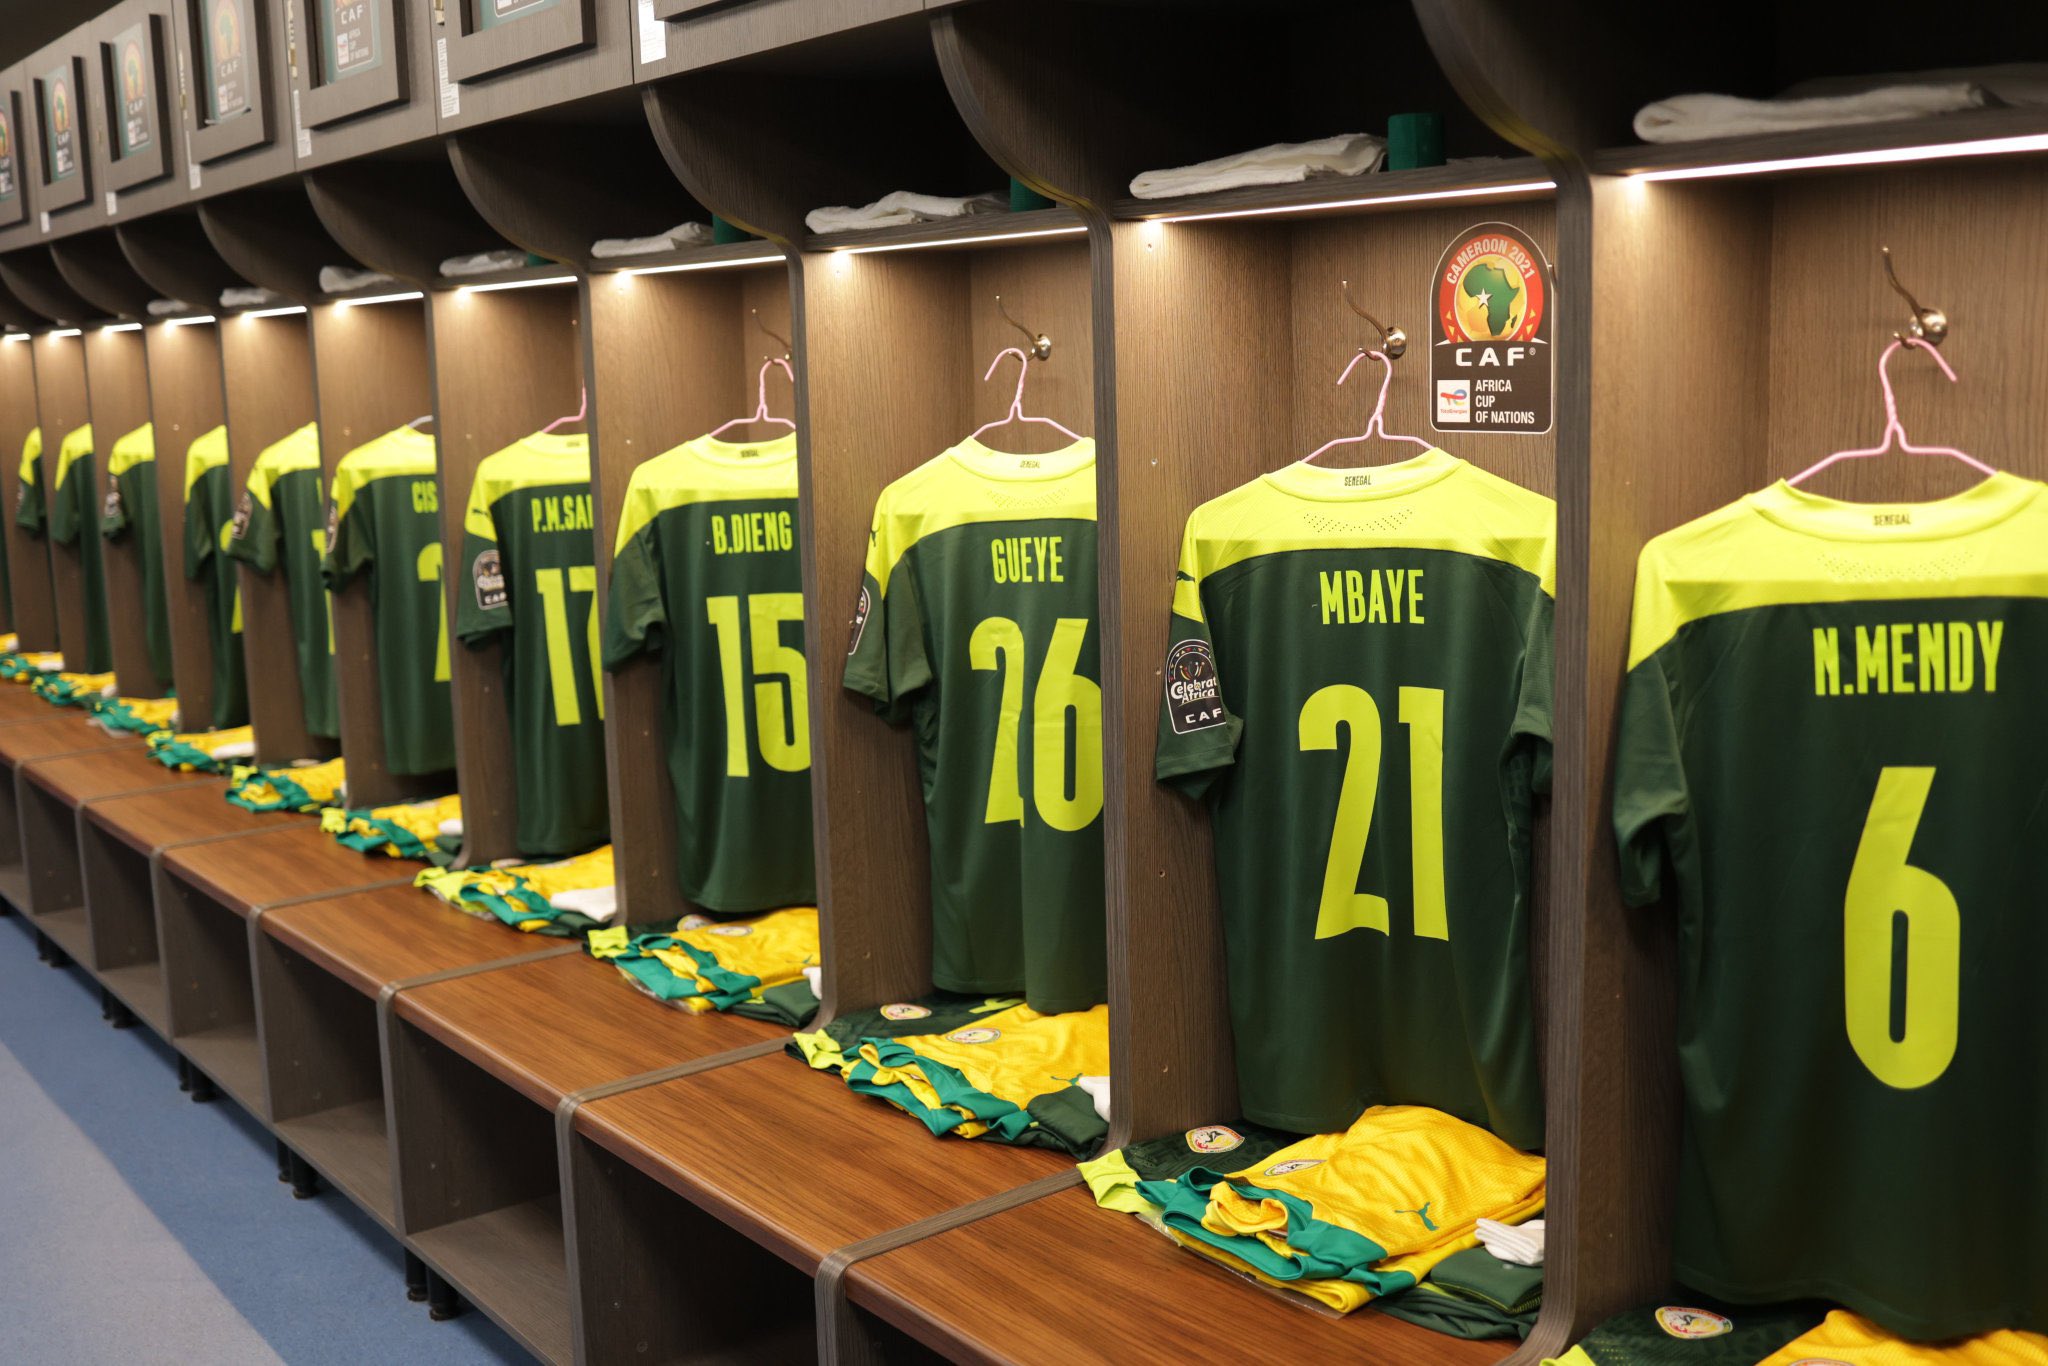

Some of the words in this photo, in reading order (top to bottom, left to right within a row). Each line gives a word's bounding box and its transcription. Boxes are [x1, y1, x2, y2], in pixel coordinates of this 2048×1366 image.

[341, 4, 364, 25] CAF
[1446, 238, 1508, 285] CAMEROON
[1508, 246, 1535, 279] 2021
[1455, 347, 1525, 367] CAF
[1475, 380, 1512, 392] AFRICA
[1475, 395, 1496, 408] CUP
[1475, 411, 1488, 423] OF
[1491, 411, 1535, 424] NATIONS
[1344, 475, 1372, 487] SENEGAL
[711, 510, 793, 555] B.DIENG
[1873, 513, 1912, 526] SENEGAL
[990, 535, 1065, 585] GUEYE
[1319, 568, 1425, 626] MBAYE
[1812, 620, 2004, 696] N.MENDY
[706, 592, 812, 777] 15
[1182, 688, 1216, 705] Africa
[969, 616, 1104, 832] 26
[1185, 707, 1222, 724] CAF
[1298, 683, 1449, 941] 21
[1844, 766, 1961, 1090] 6
